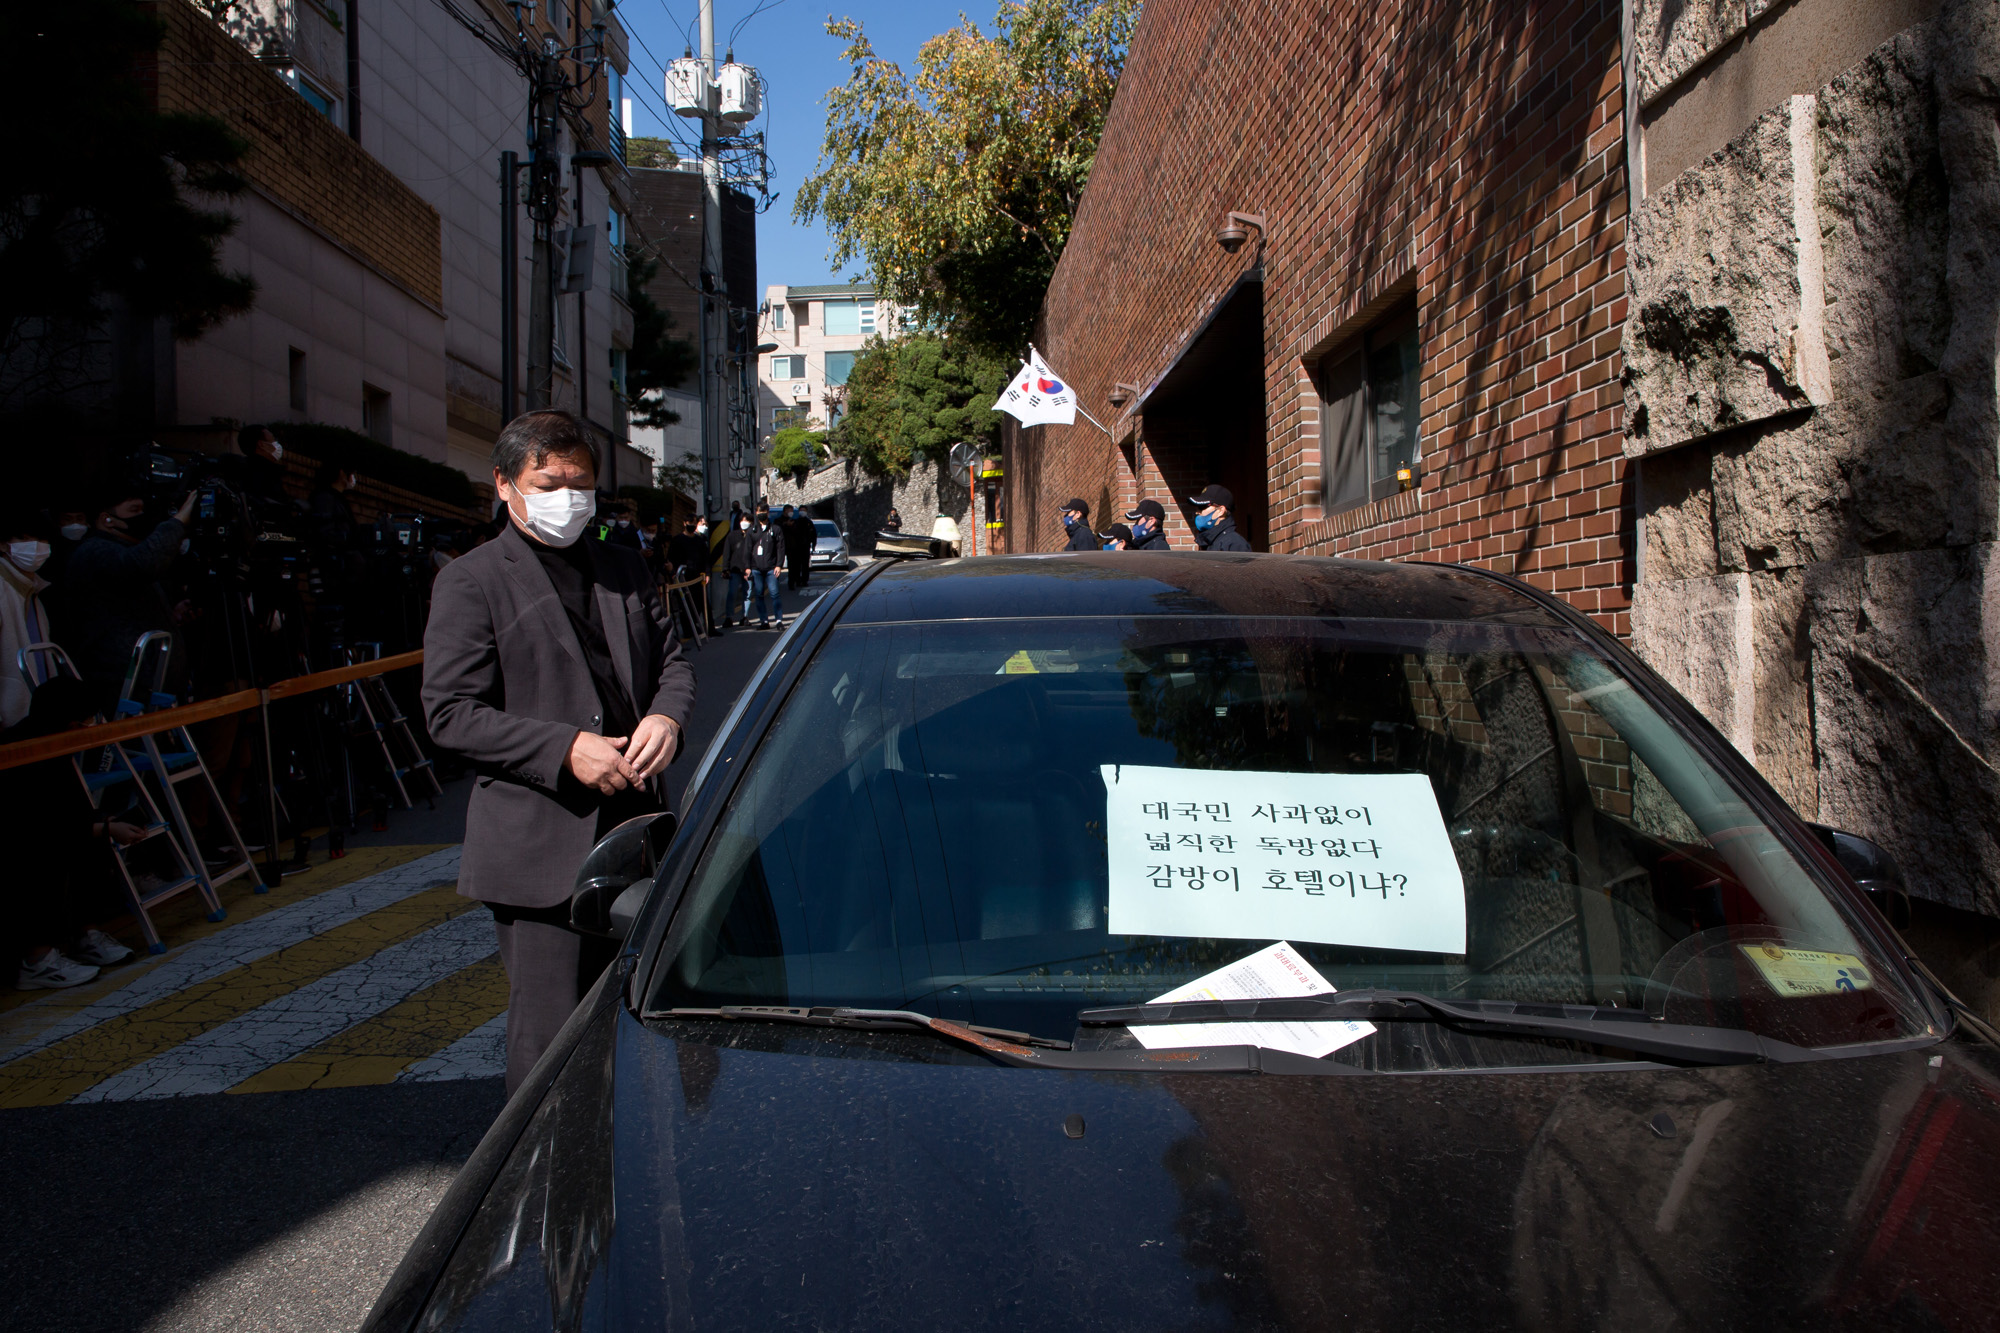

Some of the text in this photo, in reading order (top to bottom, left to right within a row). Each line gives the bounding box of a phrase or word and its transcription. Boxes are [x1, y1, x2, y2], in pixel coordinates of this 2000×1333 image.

[1142, 801, 1372, 826] 대국민 사과없이
[1145, 832, 1382, 859] 넓직한 독방없다
[1146, 864, 1408, 899] 감방이 호텔이냐?
[1274, 952, 1309, 984] 과태료부과
